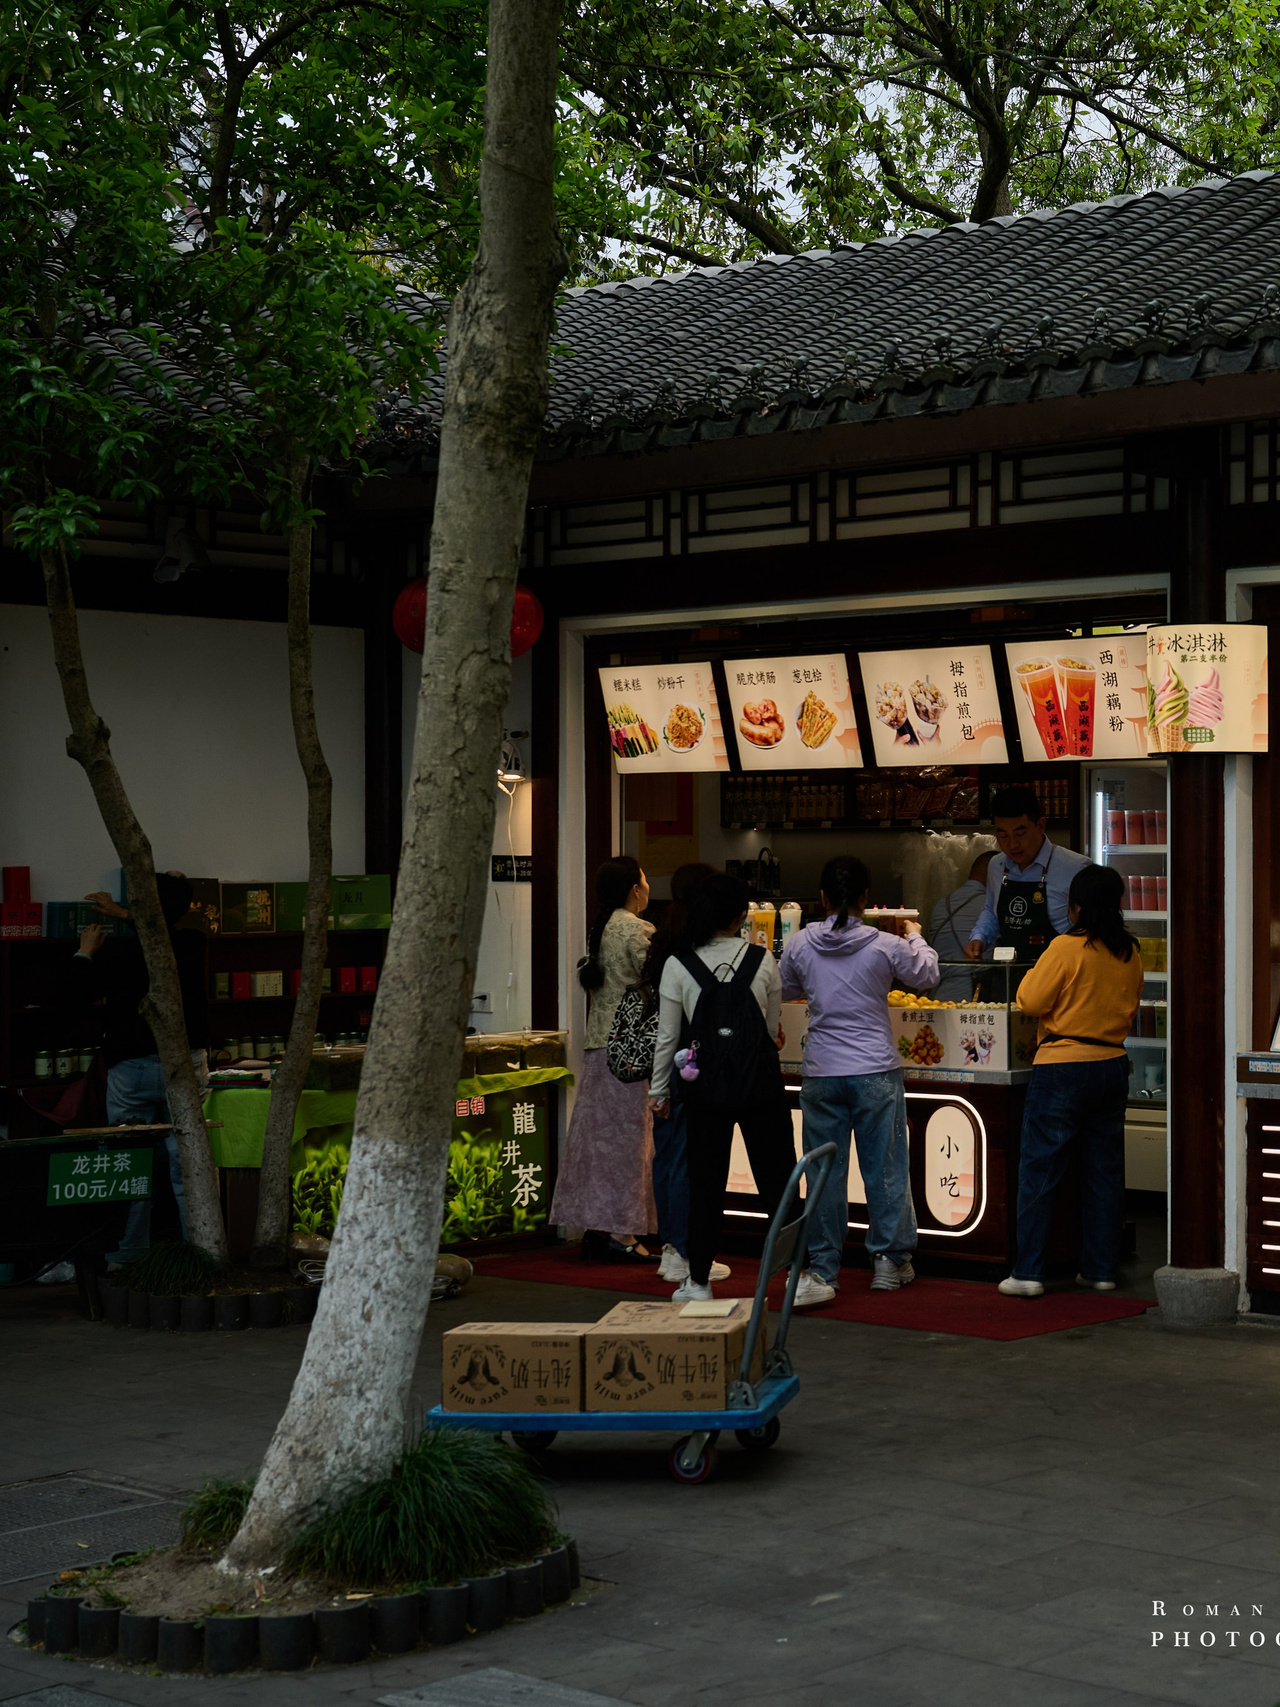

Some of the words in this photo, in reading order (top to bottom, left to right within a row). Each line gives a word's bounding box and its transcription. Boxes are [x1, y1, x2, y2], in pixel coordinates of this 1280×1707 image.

[1167, 632, 1228, 653] 冰淇淋
[736, 671, 776, 686] 脆皮烤肠
[950, 660, 975, 740] 拇指煎包
[1100, 650, 1125, 732] 西湖藕粉
[901, 1012, 935, 1023] 香煎土豆
[960, 1013, 995, 1026] 拇指煎包
[71, 1152, 132, 1175] 龙井茶
[502, 1102, 543, 1208] 龍井茶
[940, 1134, 960, 1198] 小吃
[52, 1176, 149, 1200] 100元/4罐
[510, 1359, 572, 1389] 纯牛奶
[657, 1353, 718, 1385] 纯牛奶
[449, 1384, 475, 1405] milk
[480, 1386, 509, 1405] Pure
[593, 1380, 621, 1401] milk
[626, 1383, 655, 1401] Pure
